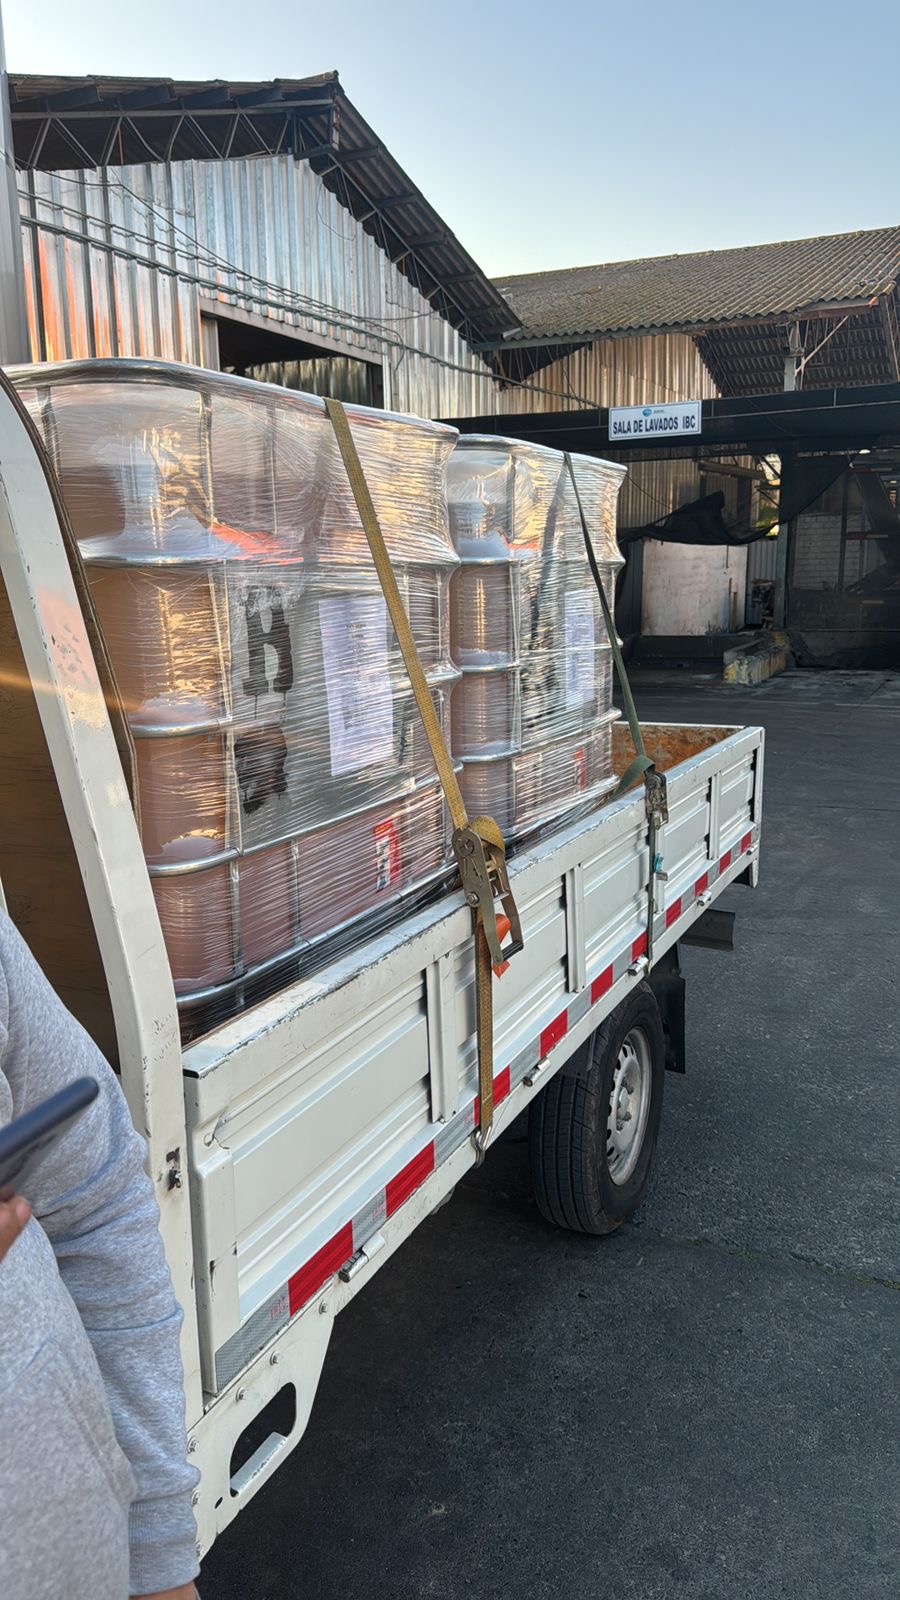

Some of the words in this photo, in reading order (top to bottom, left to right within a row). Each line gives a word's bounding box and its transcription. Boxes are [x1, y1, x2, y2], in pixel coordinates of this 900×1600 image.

[613, 420, 632, 435] SALA
[633, 419, 643, 433] DE
[645, 417, 679, 432] LAVADOS
[682, 415, 696, 429] IBC
